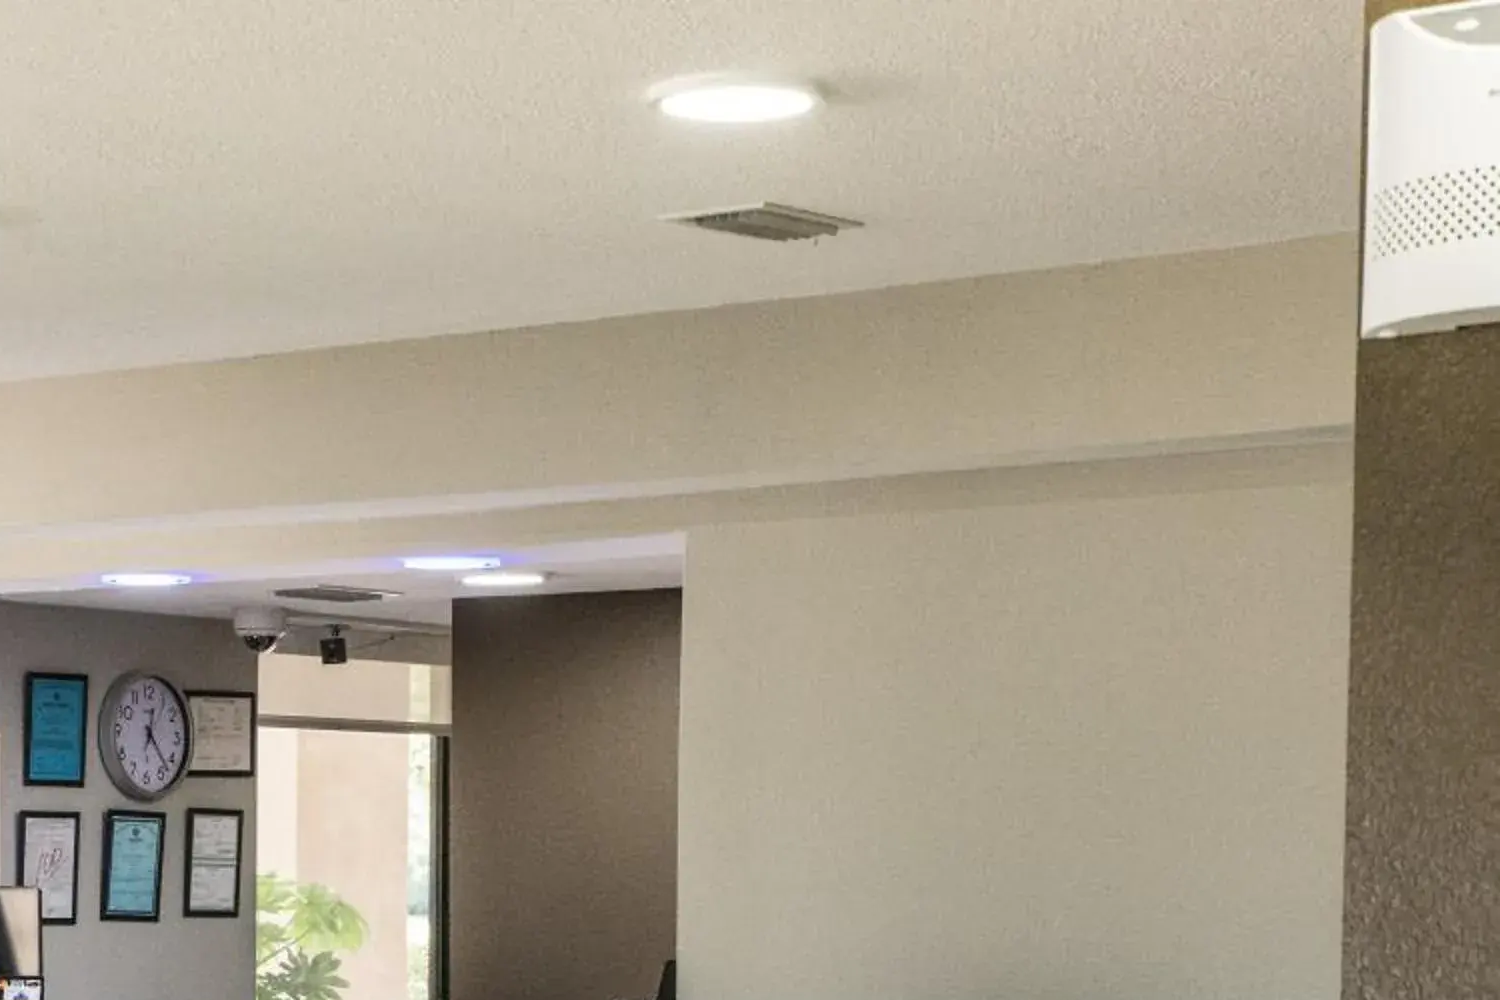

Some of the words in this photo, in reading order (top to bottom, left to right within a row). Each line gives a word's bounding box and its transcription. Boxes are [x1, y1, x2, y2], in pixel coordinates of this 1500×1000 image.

[131, 690, 139, 705] 11
[143, 683, 155, 700] 12
[115, 704, 133, 721] 10
[167, 707, 177, 723] 2
[115, 723, 123, 737] 9
[172, 731, 181, 746] 3
[168, 751, 176, 764] 4
[129, 761, 137, 775] 7
[156, 765, 165, 781] 5
[142, 770, 151, 785] 6
